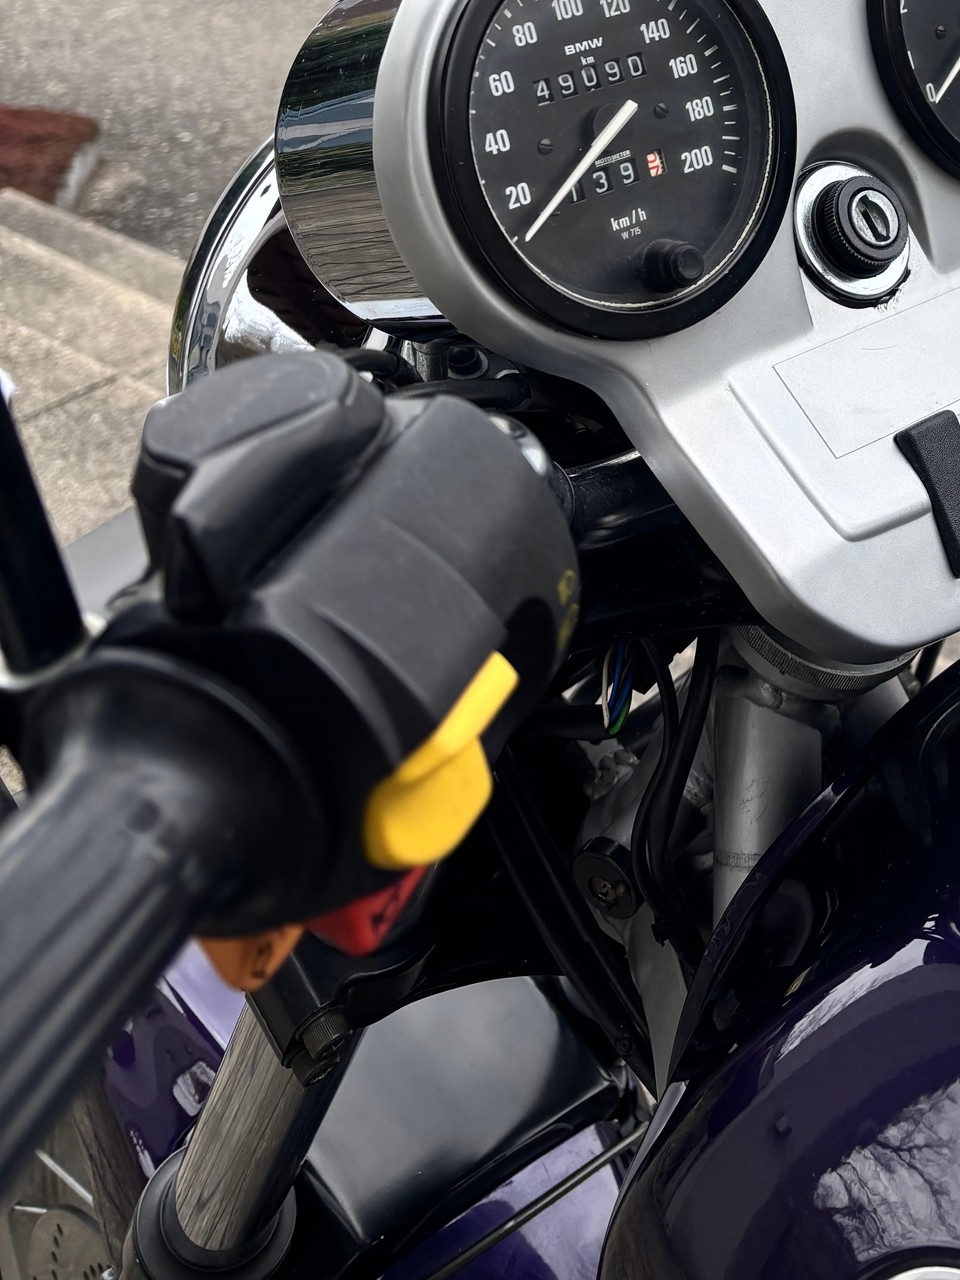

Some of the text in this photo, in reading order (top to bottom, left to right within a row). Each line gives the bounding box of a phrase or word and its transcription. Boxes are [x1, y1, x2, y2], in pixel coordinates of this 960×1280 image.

[512, 21, 538, 47] 80
[639, 18, 671, 44] 140
[564, 36, 604, 56] BMW
[580, 56, 595, 66] km
[668, 53, 699, 79] 160
[488, 70, 515, 97] 60
[925, 83, 936, 102] 0
[685, 96, 715, 122] 180
[484, 129, 511, 155] 40
[680, 145, 714, 174] 200
[505, 182, 532, 210] 20
[610, 207, 648, 232] km/h
[621, 231, 630, 240] W
